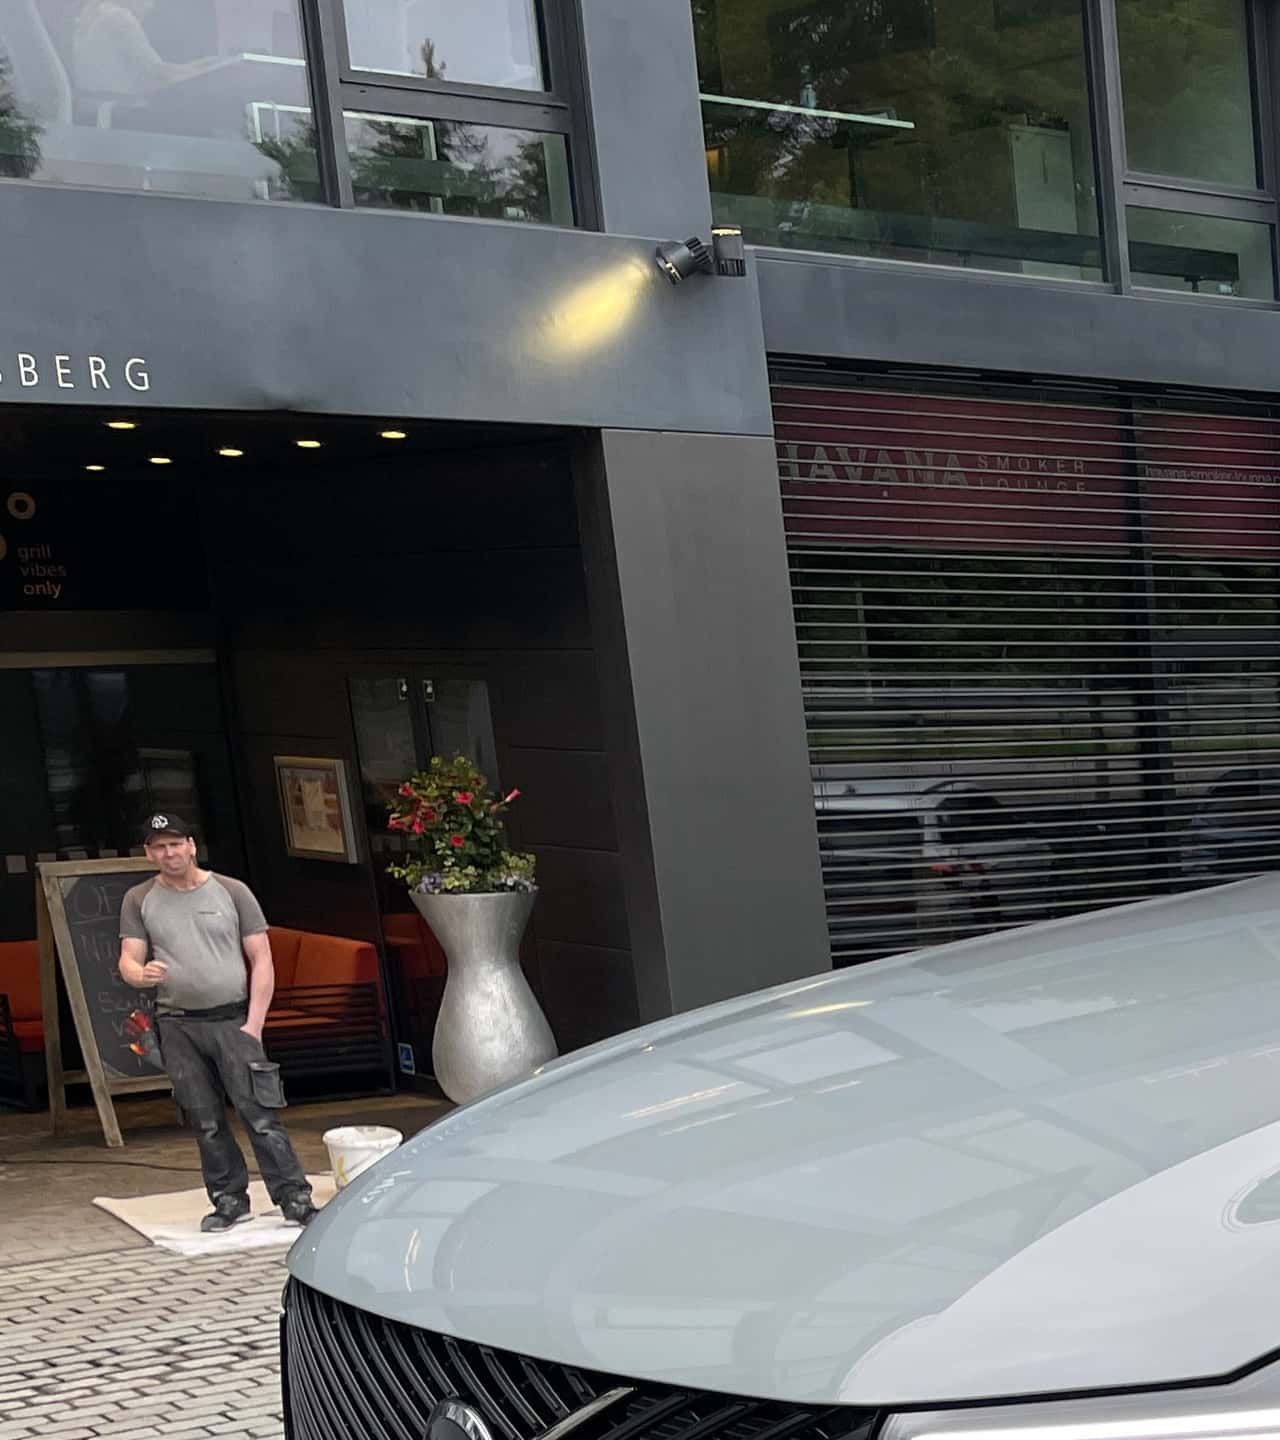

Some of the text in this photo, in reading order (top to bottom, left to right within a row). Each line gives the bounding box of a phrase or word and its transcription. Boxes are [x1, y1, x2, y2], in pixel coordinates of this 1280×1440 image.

[0, 352, 151, 392] BERG
[977, 455, 1087, 474] SMOKER
[23, 578, 62, 600] only
